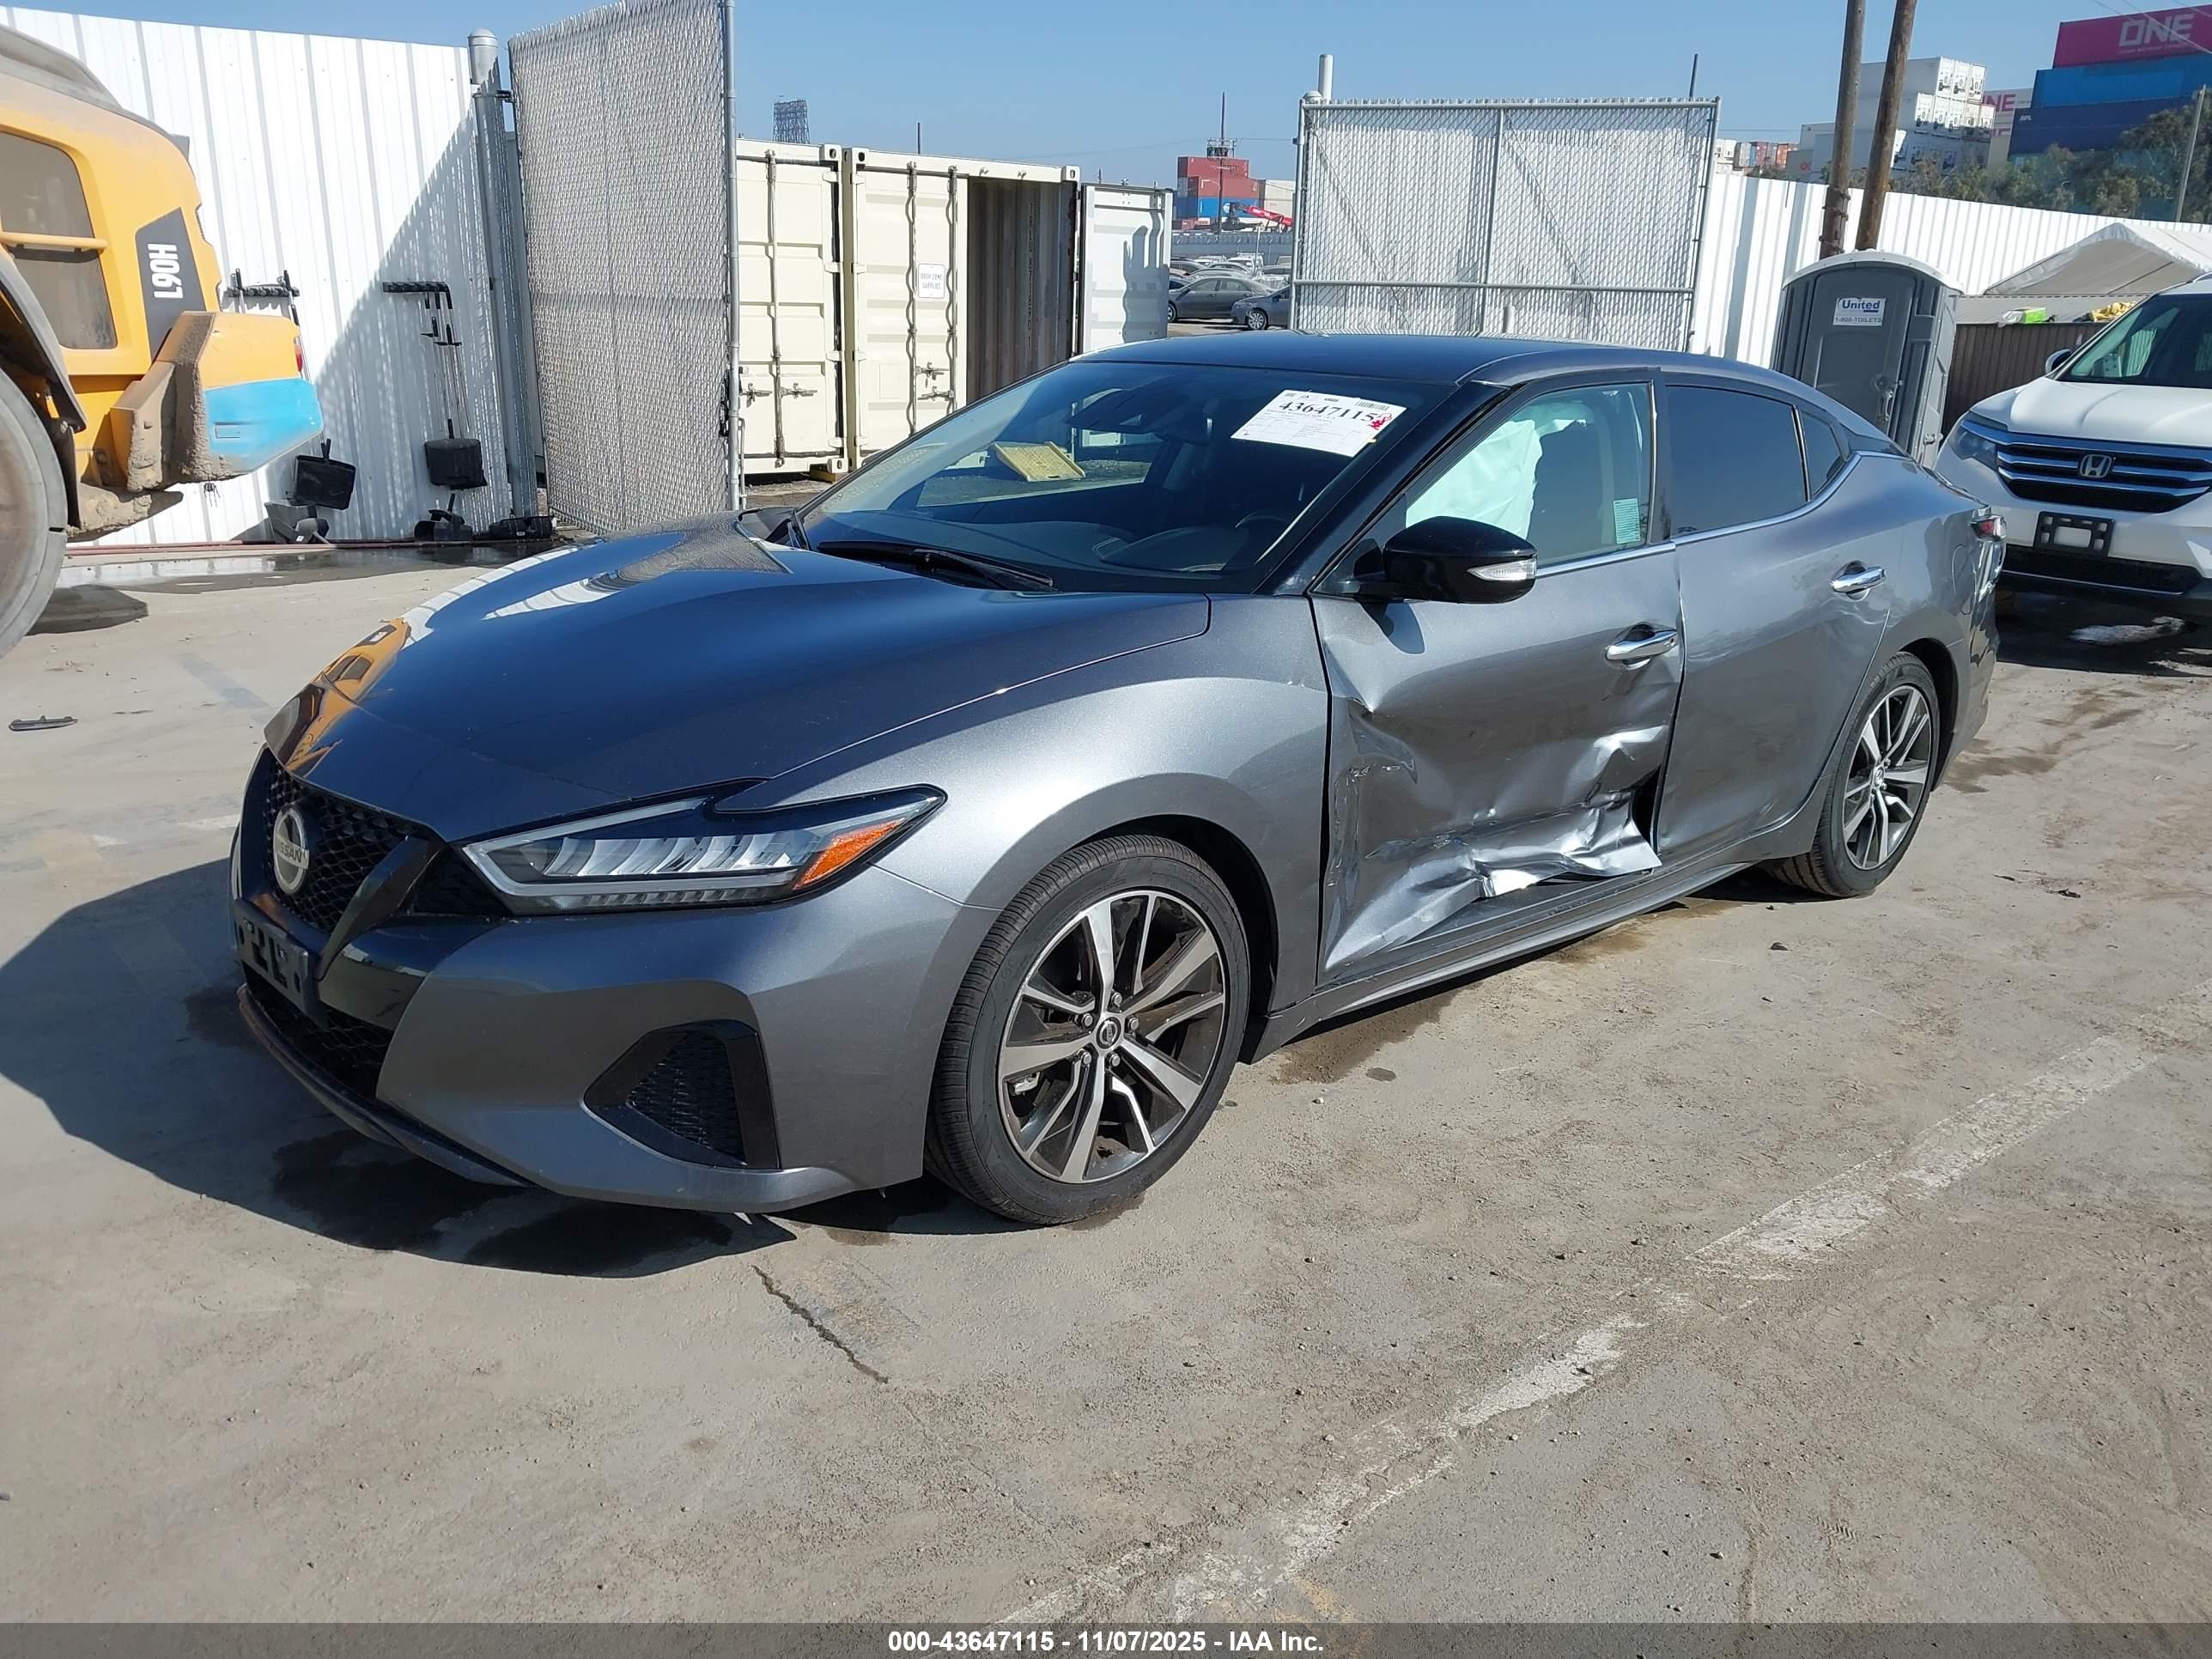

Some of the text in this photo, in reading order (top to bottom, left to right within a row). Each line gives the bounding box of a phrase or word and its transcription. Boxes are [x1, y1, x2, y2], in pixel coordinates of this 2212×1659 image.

[2118, 13, 2195, 47] ONE
[1982, 94, 2016, 112] NE
[147, 243, 184, 299] L90H
[1842, 299, 1881, 309] United
[1279, 401, 1378, 422] 43647115
[280, 842, 302, 863] SSAN
